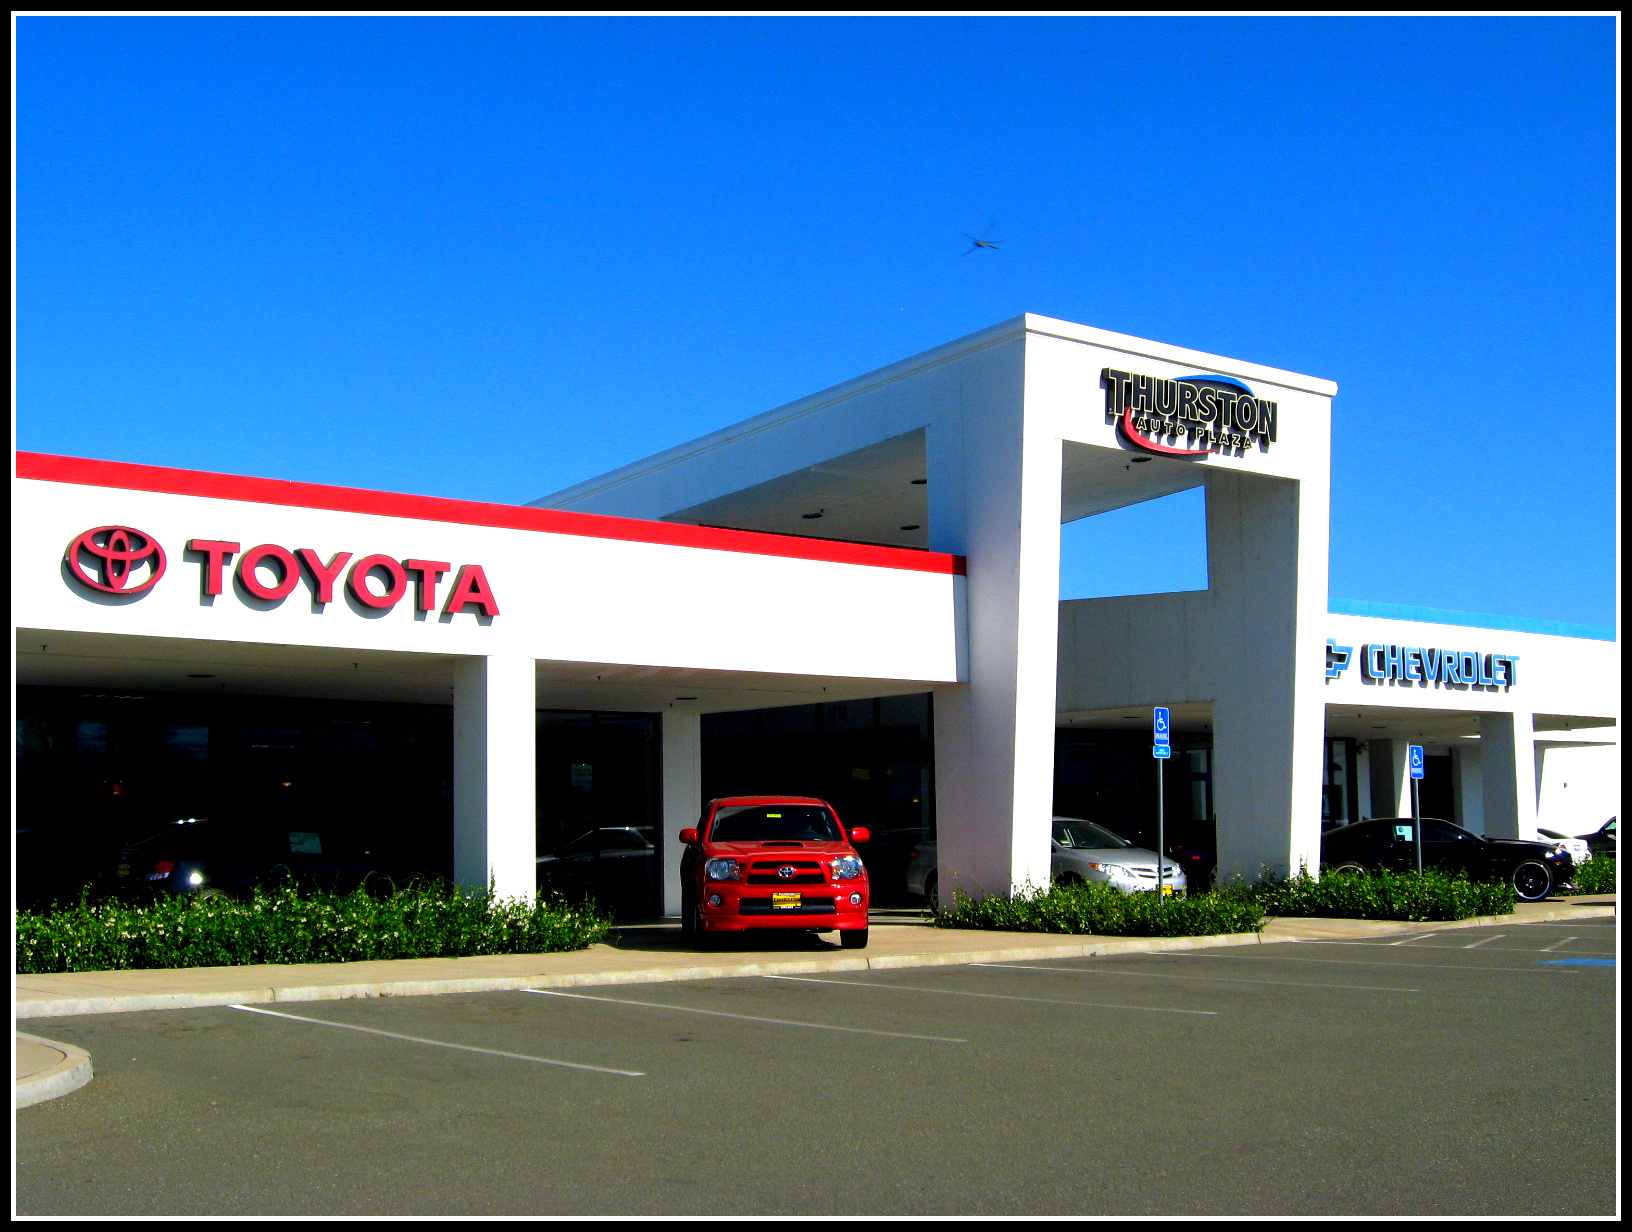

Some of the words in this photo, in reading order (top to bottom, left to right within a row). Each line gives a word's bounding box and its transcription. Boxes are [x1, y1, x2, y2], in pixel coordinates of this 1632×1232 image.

[1103, 367, 1277, 445] THURSTON
[1136, 417, 1186, 437] AUTO
[1195, 429, 1253, 450] PLAZA
[187, 538, 500, 617] TOYOTA
[1365, 643, 1520, 686] CHEVROLET
